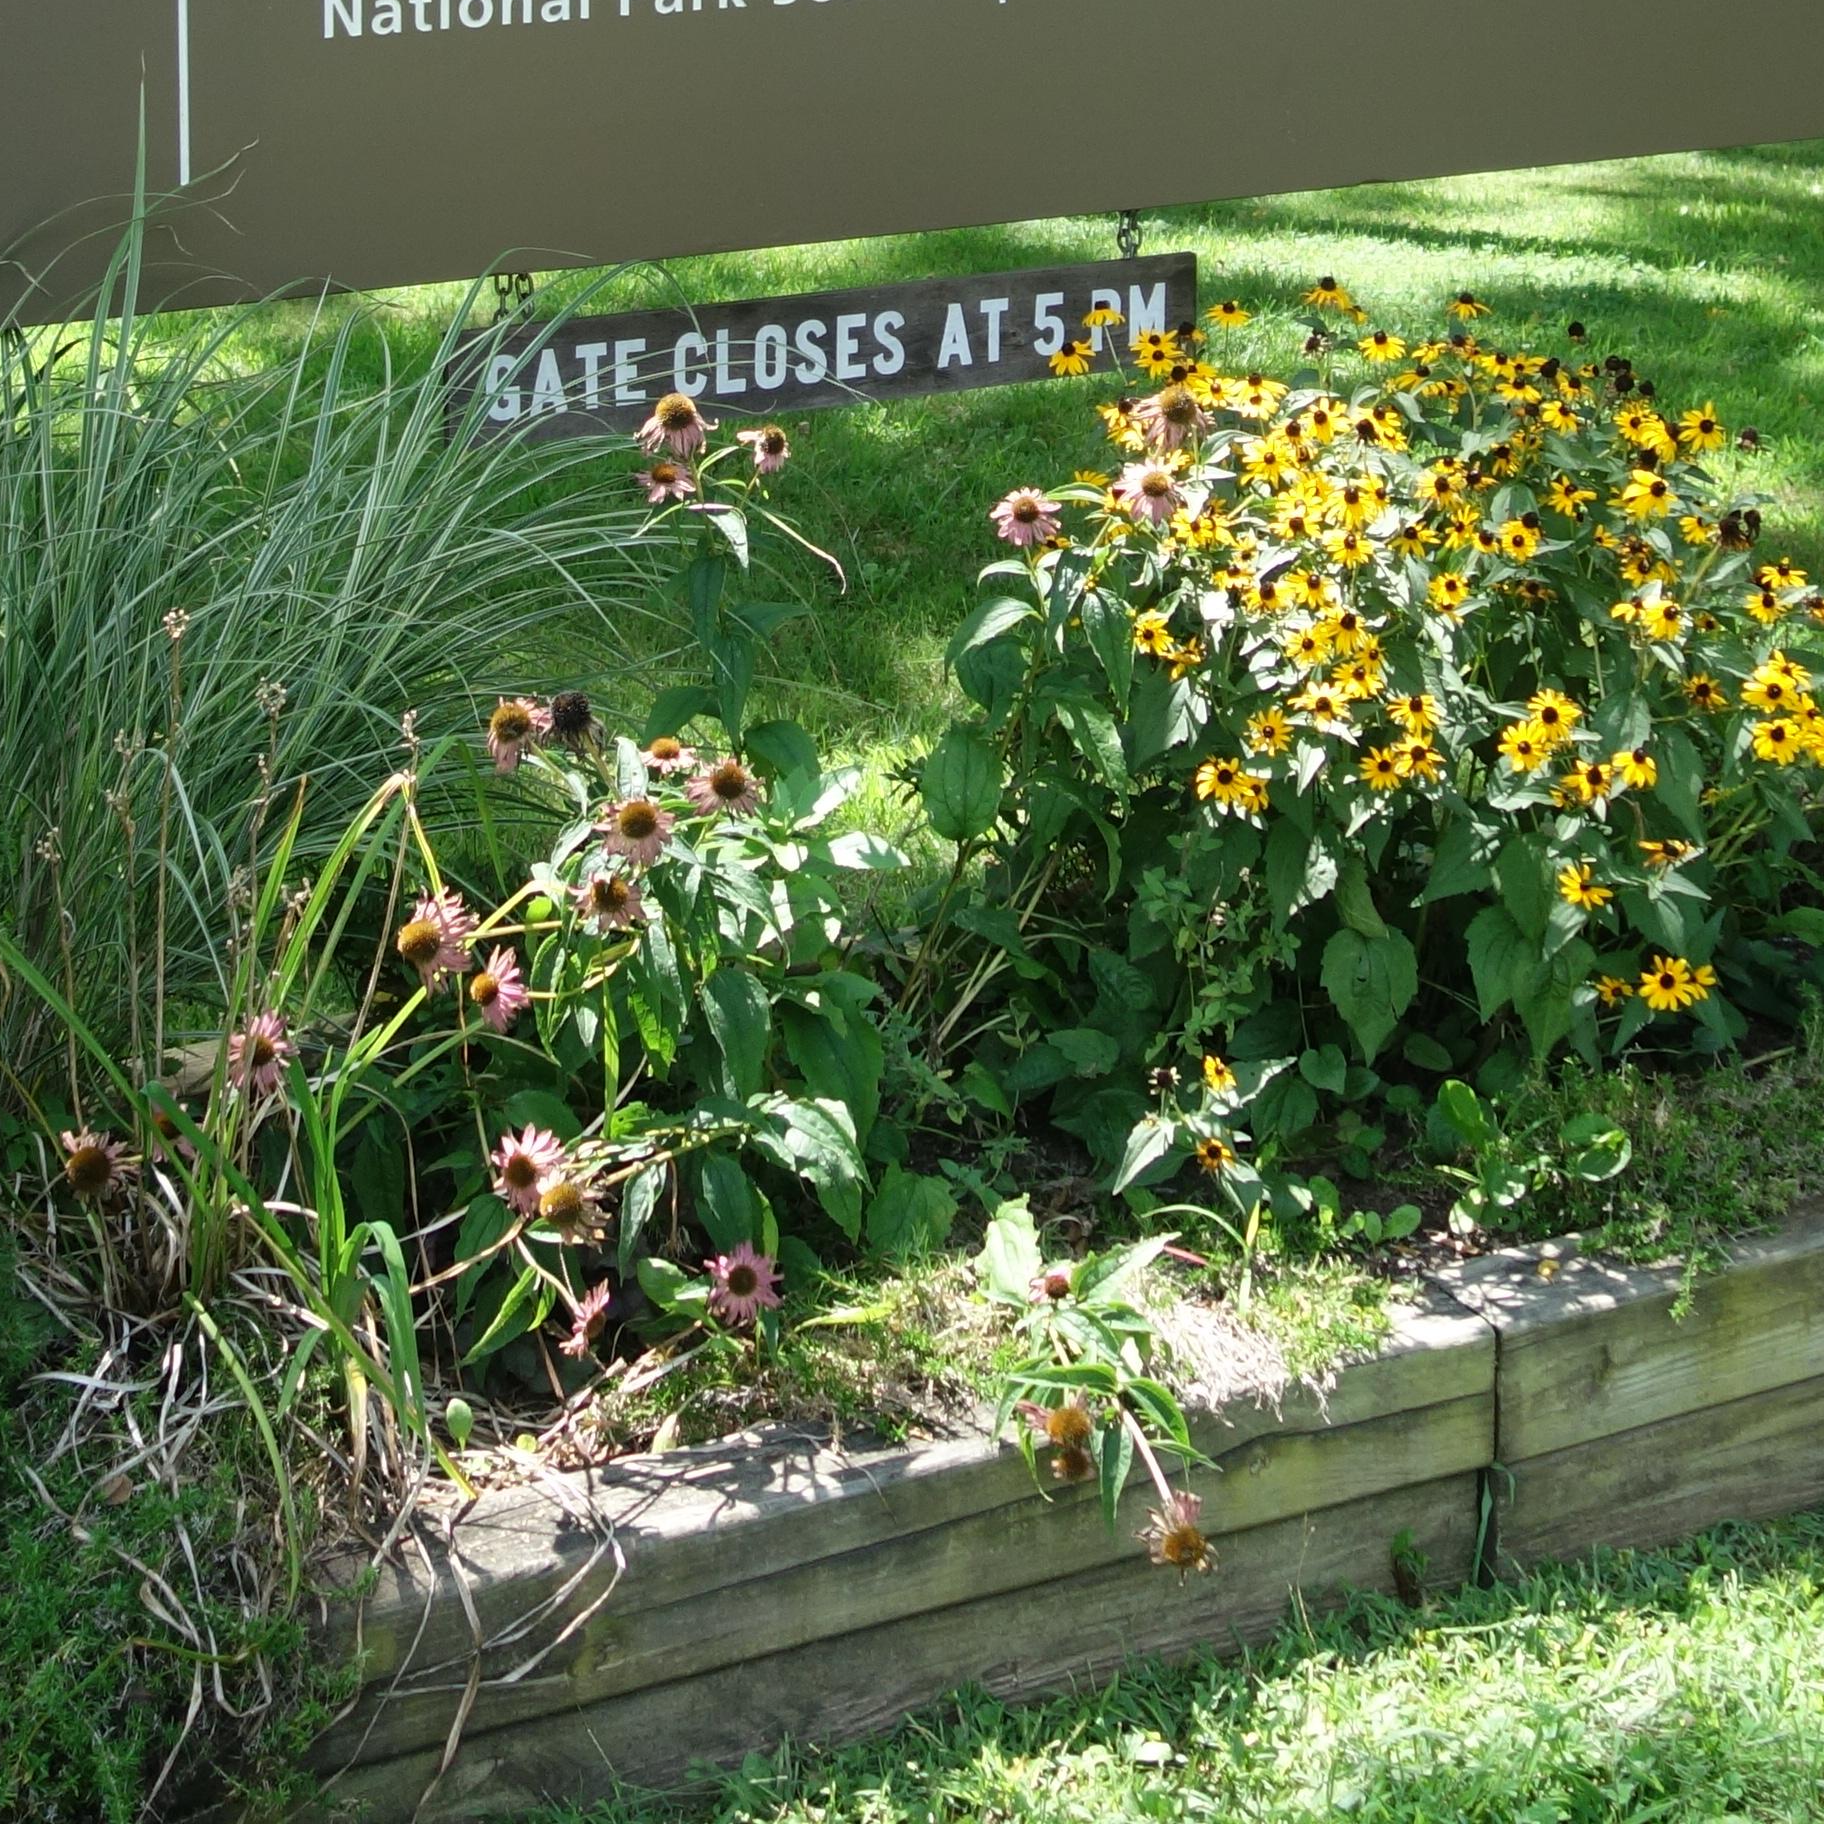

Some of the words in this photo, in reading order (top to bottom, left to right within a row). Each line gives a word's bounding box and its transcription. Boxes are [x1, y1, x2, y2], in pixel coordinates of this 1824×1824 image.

[485, 338, 647, 422] GATE
[673, 310, 905, 397] CLOSES
[936, 297, 1009, 368] AT
[1033, 291, 1065, 357] 5
[1091, 282, 1167, 353] PM
